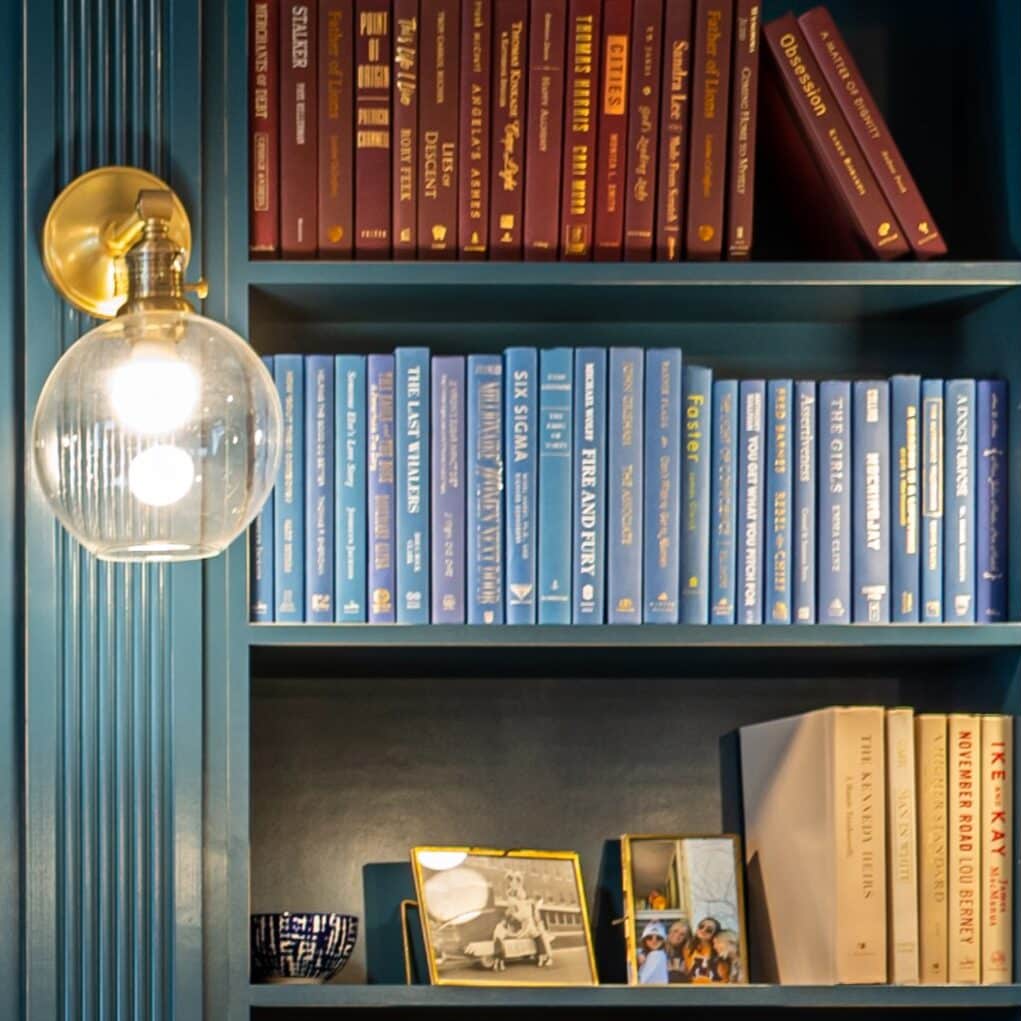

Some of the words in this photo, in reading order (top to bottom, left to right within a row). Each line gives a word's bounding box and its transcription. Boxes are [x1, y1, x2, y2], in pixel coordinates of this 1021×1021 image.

[292, 6, 308, 68] STALKER
[575, 16, 592, 73] THOMAS
[705, 11, 721, 56] Father
[608, 44, 623, 106] CITIES
[671, 41, 689, 91] Sandra
[705, 61, 720, 76] of
[780, 33, 827, 117] Obsession
[572, 80, 591, 132] HARRIS
[671, 94, 687, 119] Lee
[703, 80, 718, 119] Lions
[740, 67, 752, 109] COMING
[470, 84, 481, 160] ANGELA'S
[739, 111, 749, 141] HOME
[425, 131, 438, 199] DESCENT
[571, 146, 588, 175] CARI
[470, 169, 480, 218] ASHES
[570, 180, 587, 215] MORA
[408, 367, 420, 398] THE
[514, 371, 528, 398] SIX
[407, 401, 420, 439] LAST
[514, 404, 528, 463] SIGMA
[686, 395, 704, 462] Faster
[830, 398, 843, 433] THE
[748, 436, 759, 461] YOU
[799, 395, 814, 482] Assertiveness
[407, 441, 420, 514] WHALERS
[581, 448, 596, 487] FIRE
[748, 463, 758, 484] GET
[830, 440, 843, 493] GIRLS
[581, 490, 596, 527] AND
[747, 487, 758, 520] WHAT
[865, 453, 881, 550] MOCKINGJAY
[581, 531, 596, 575] FURY
[746, 522, 757, 546] YOU
[746, 549, 757, 581] PITCH
[745, 584, 755, 606] FOR
[861, 735, 872, 765] THE
[959, 731, 973, 808] NOVEMBER
[991, 741, 1006, 781] IKE
[861, 772, 872, 844] KENNEDY
[959, 814, 972, 852] ROAD
[990, 810, 1006, 857] KAY
[862, 852, 873, 899] HEIRS
[959, 858, 972, 884] LOU
[999, 879, 1009, 912] James
[959, 890, 974, 944] BERNEY
